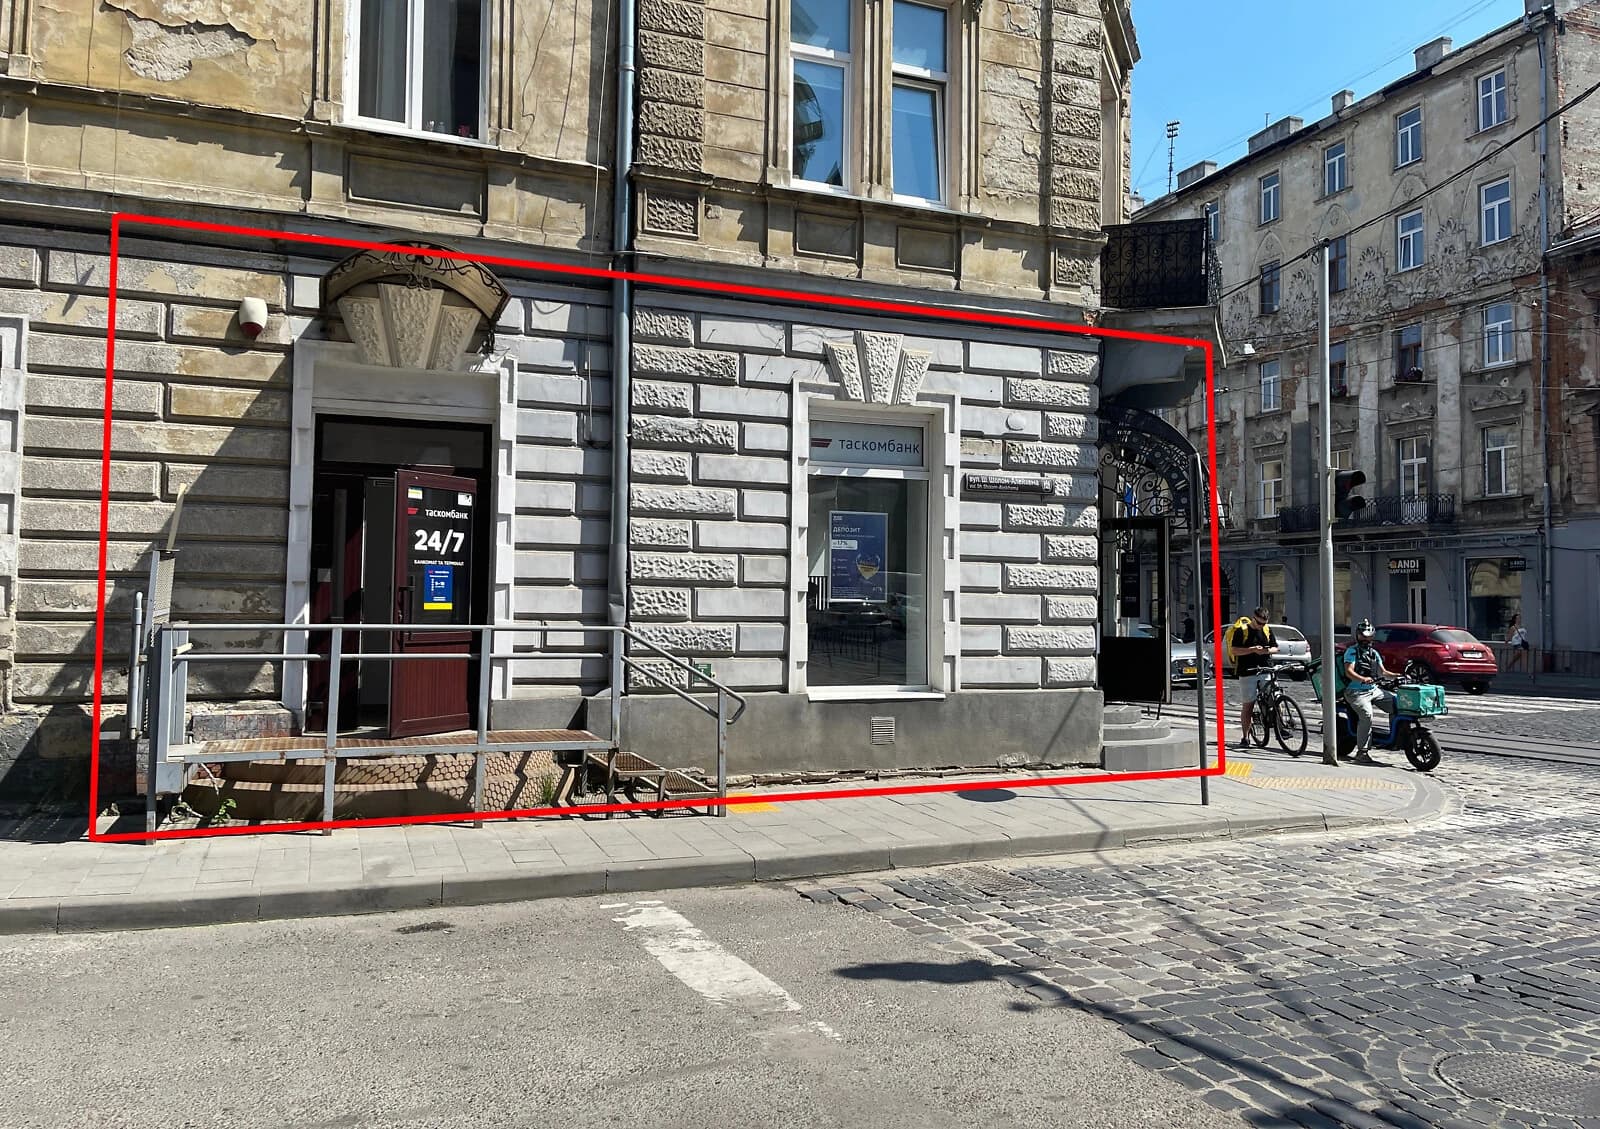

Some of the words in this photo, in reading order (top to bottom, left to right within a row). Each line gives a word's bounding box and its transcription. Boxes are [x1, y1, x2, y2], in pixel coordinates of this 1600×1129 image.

[839, 439, 920, 454] таскомбанк
[425, 509, 468, 519] таскомбанк
[414, 529, 465, 555] 24/7
